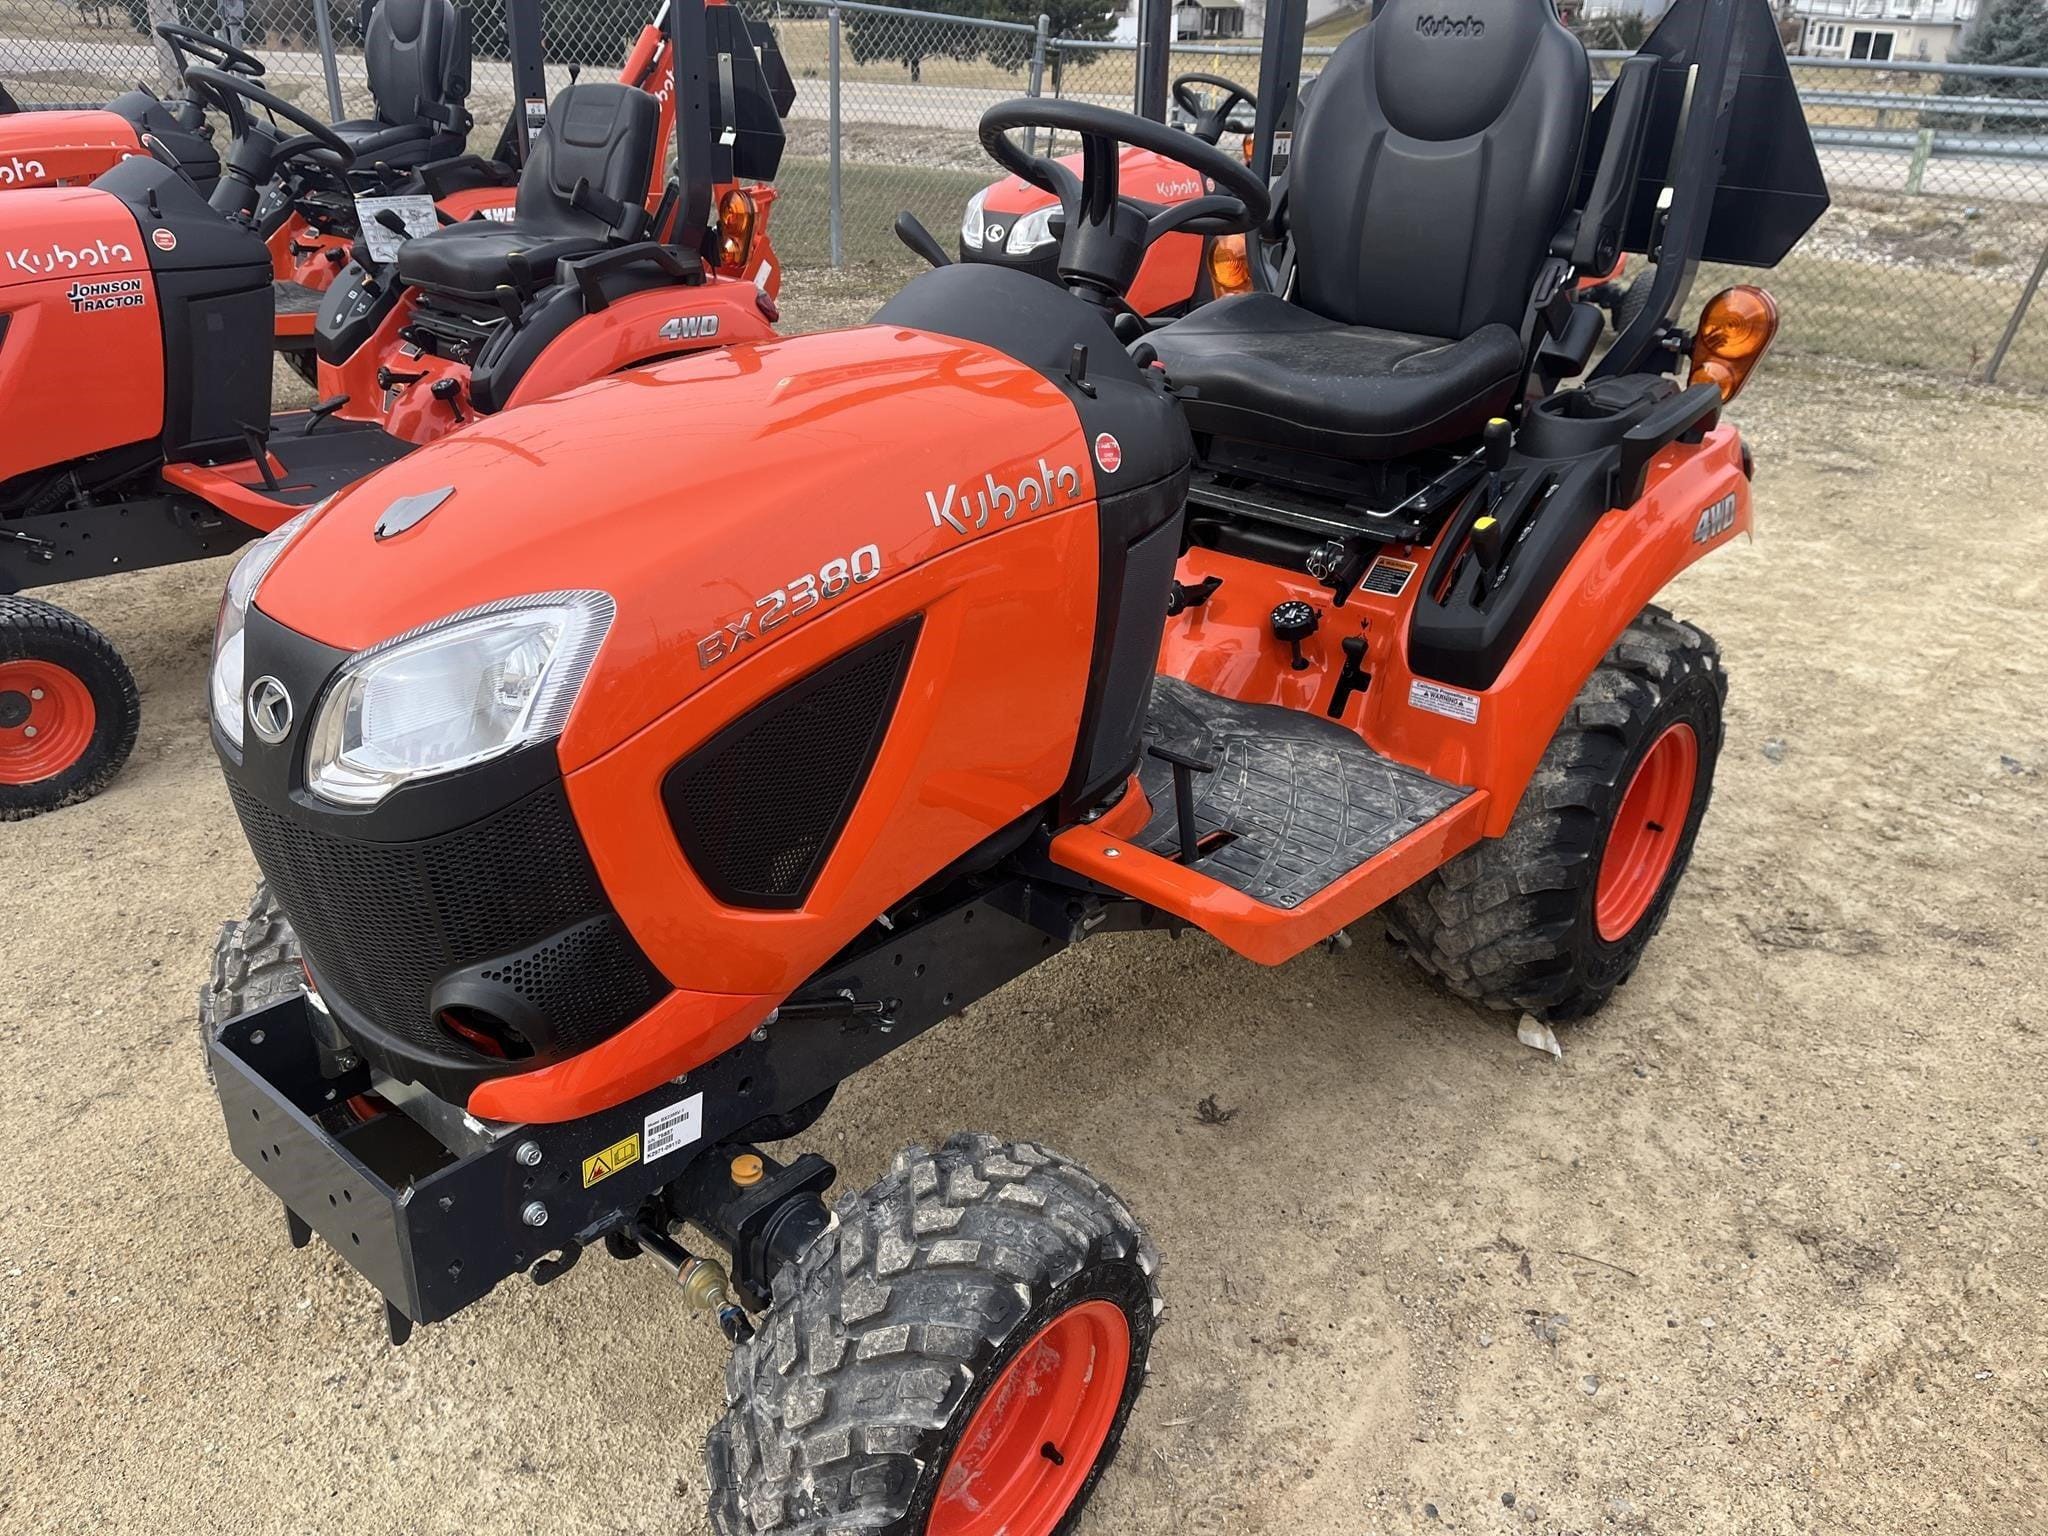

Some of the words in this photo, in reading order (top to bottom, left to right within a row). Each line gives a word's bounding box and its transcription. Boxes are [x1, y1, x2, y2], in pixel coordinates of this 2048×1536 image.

[1416, 14, 1486, 37] Kubota
[1155, 178, 1200, 197] Kubota
[6, 239, 132, 274] Kubota
[67, 279, 141, 298] JOHNSON
[70, 295, 144, 313] TRACTOR
[659, 314, 719, 340] 4WD
[925, 458, 1081, 535] Kubota
[1692, 491, 1736, 544] 4WD
[696, 543, 881, 669] BX2380
[1430, 691, 1458, 704] WARNING
